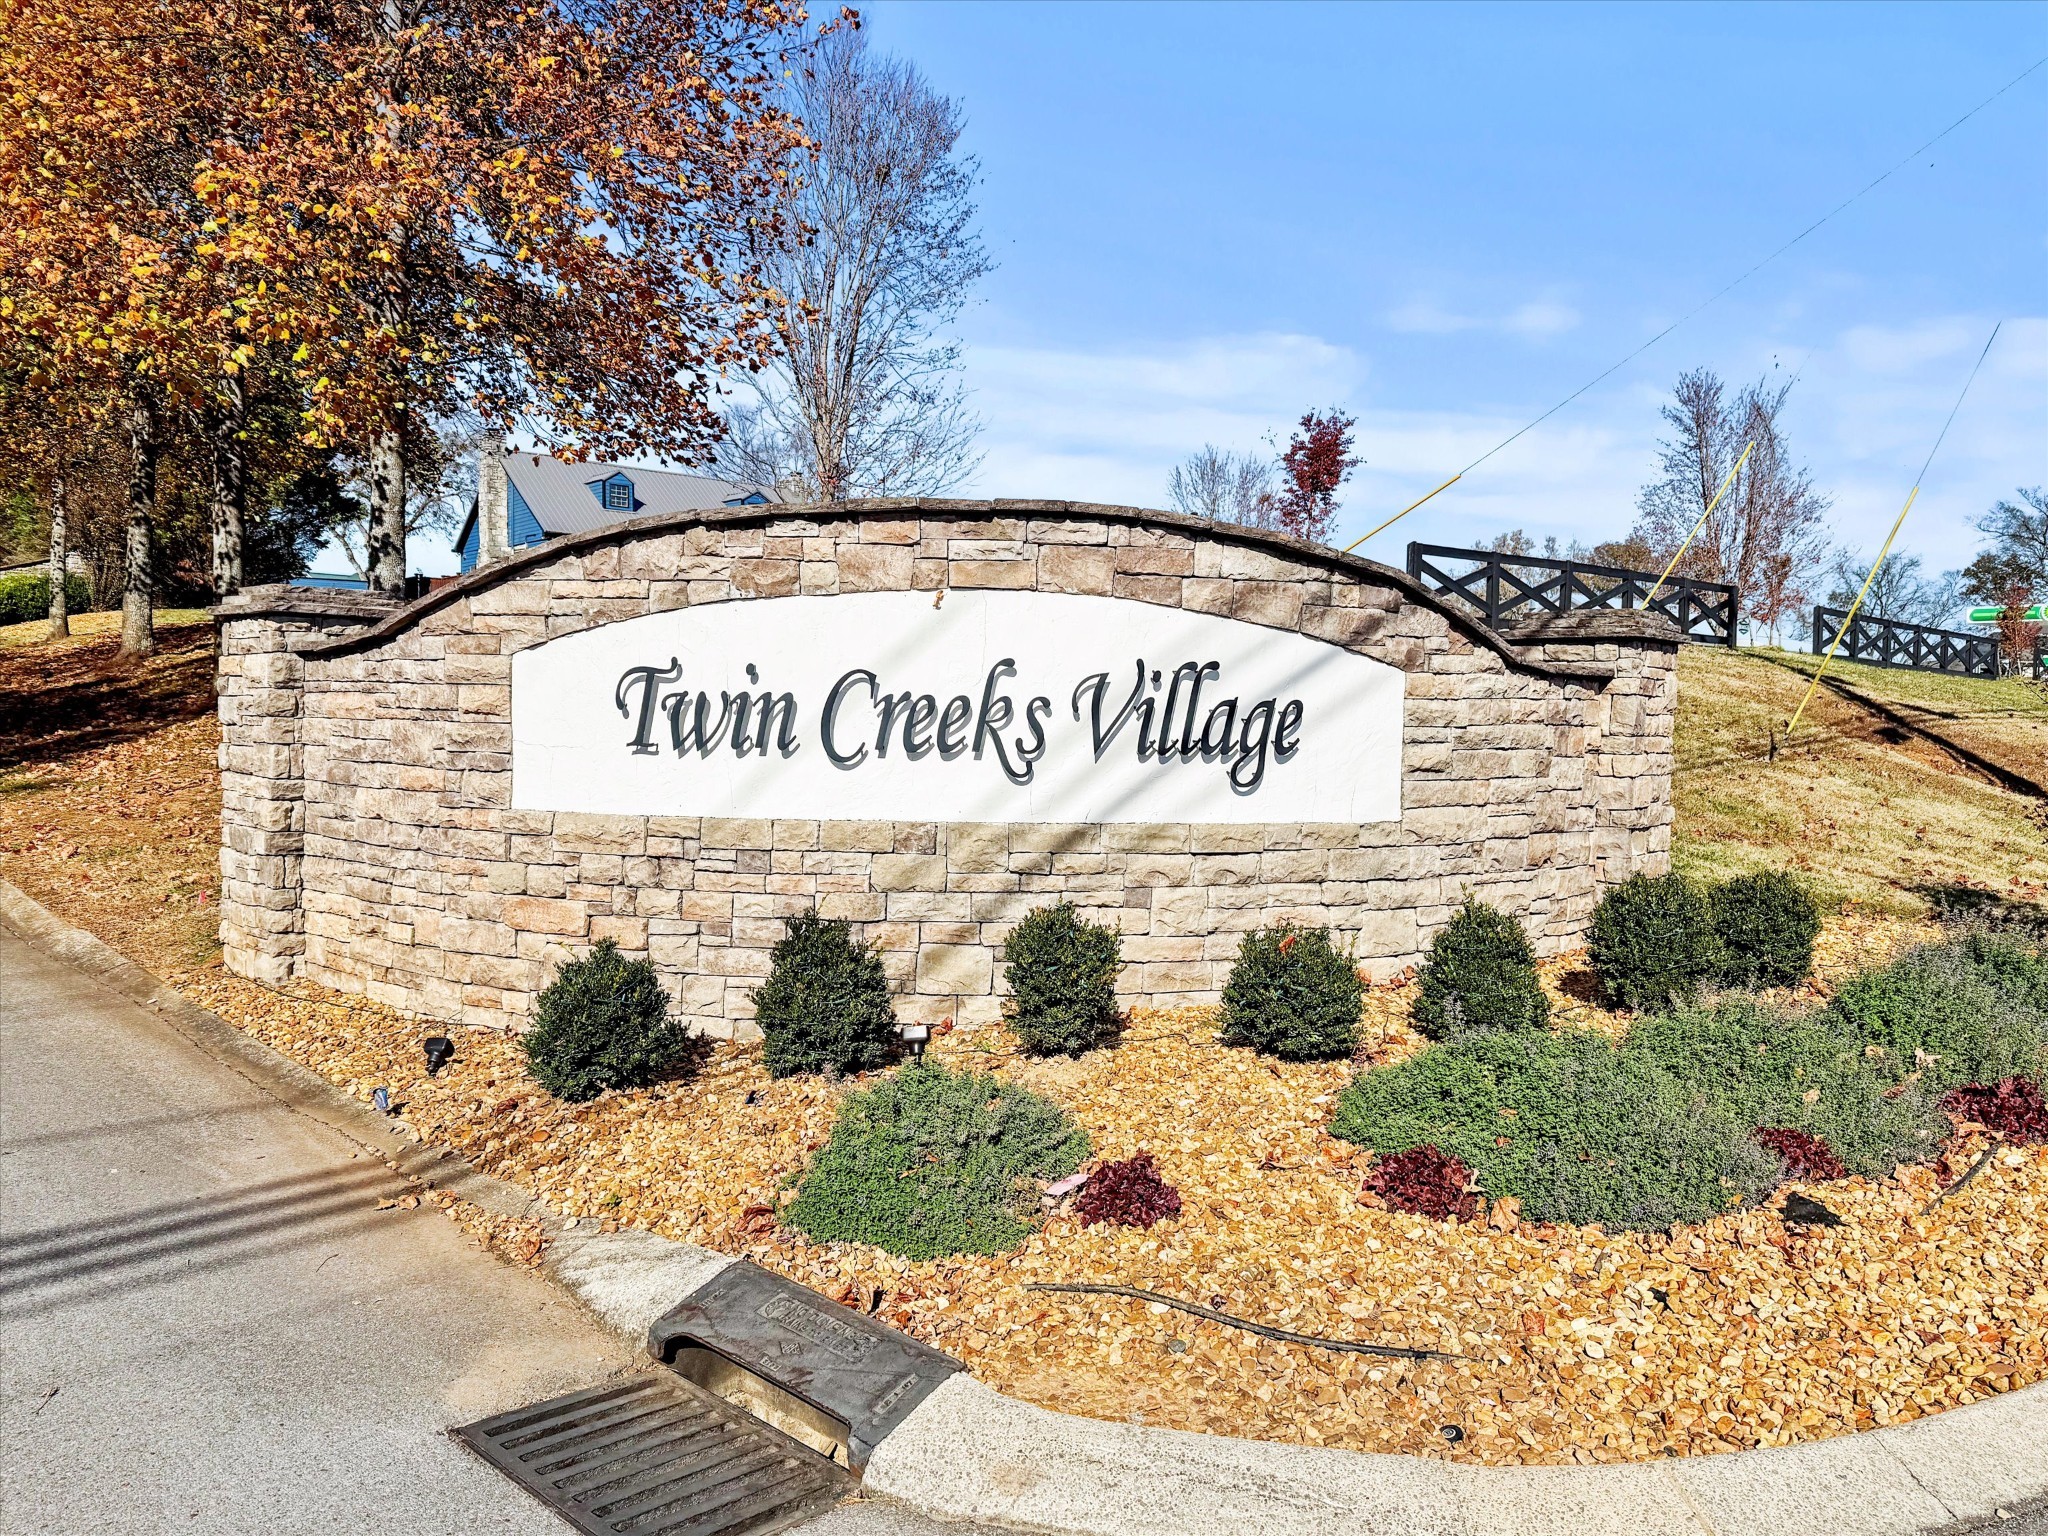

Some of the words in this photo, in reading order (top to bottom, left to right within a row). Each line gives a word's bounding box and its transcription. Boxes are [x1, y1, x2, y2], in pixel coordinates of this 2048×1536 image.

[616, 657, 798, 754] Twin
[820, 657, 1050, 778] Creeks
[1072, 658, 1305, 788] Village
